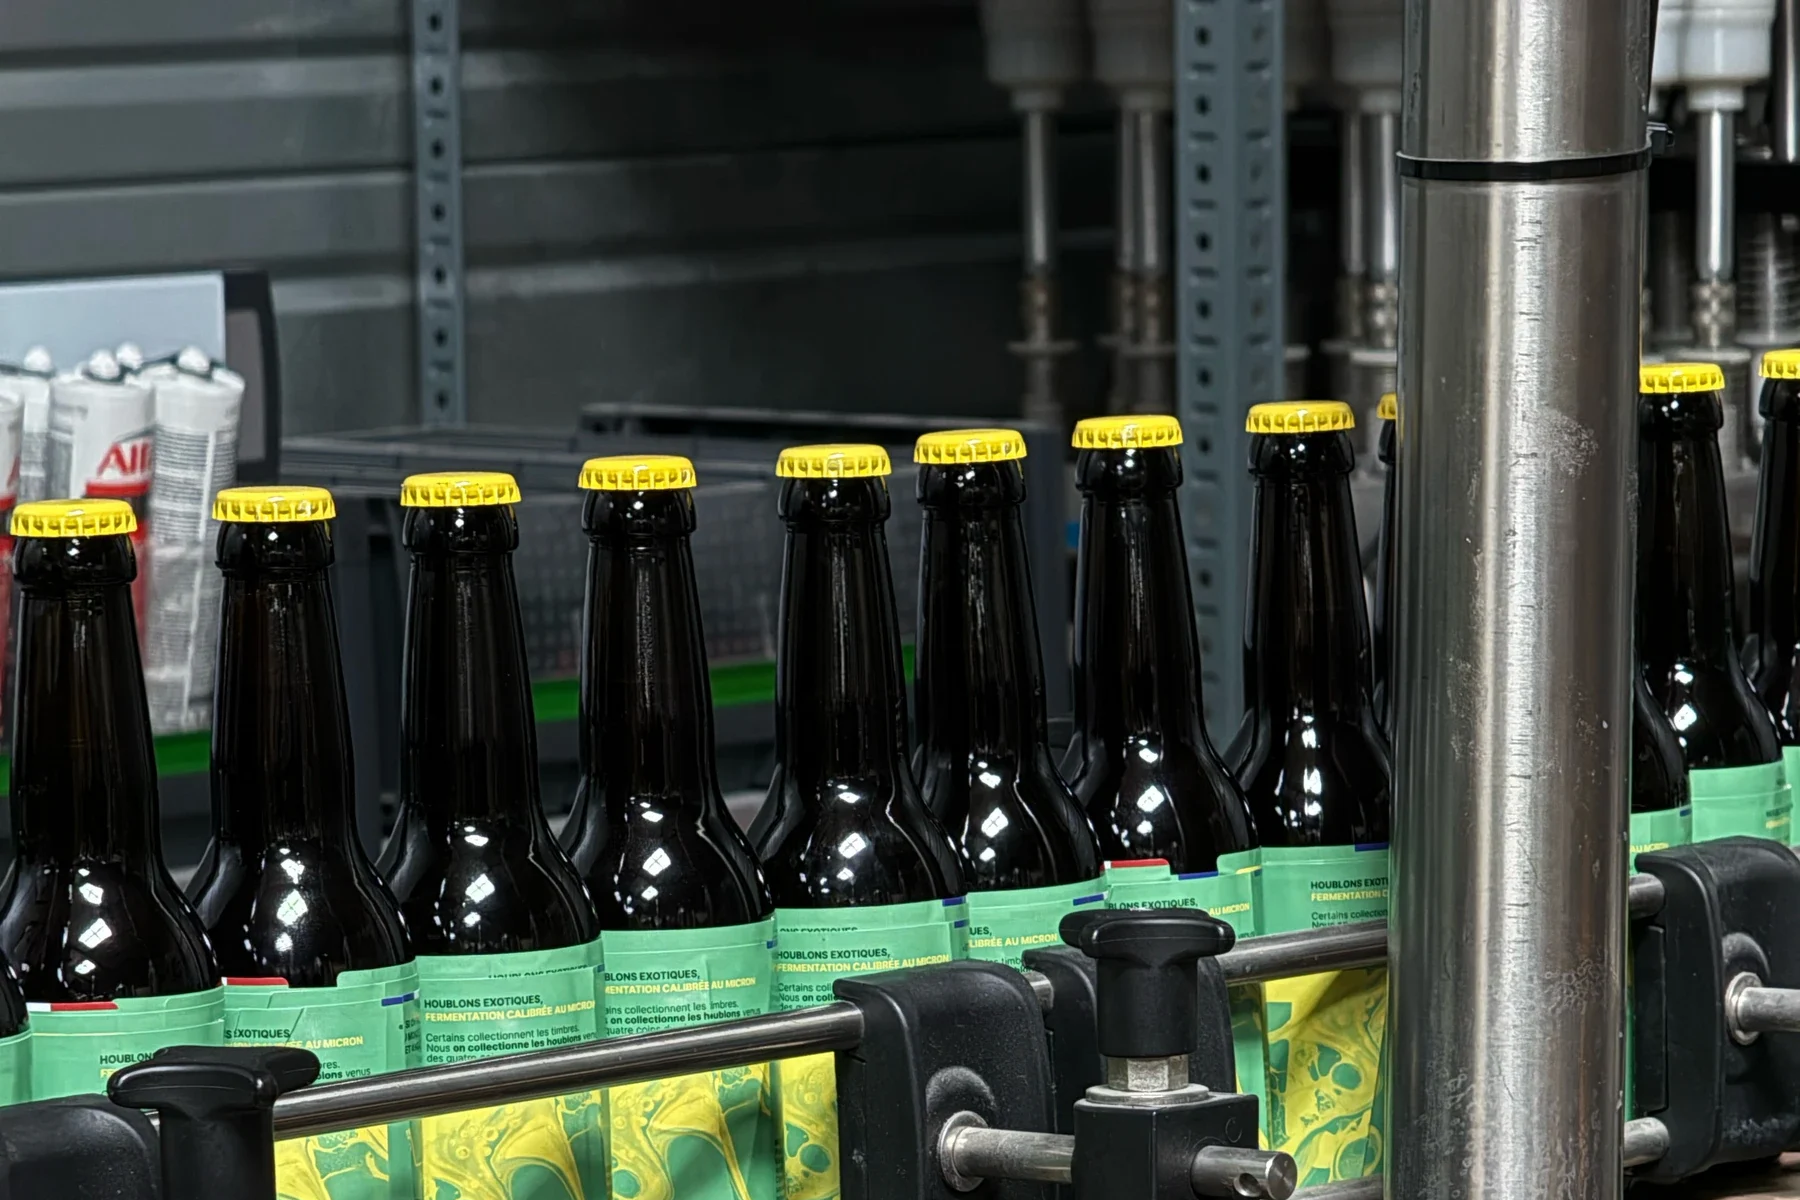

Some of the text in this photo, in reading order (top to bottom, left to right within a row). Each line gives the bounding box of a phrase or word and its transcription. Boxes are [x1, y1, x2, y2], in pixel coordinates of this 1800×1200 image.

[1311, 879, 1362, 889] HOUBLONS
[1311, 889, 1381, 901] FERMENTATION
[1209, 902, 1250, 916] AU MICRON
[1311, 910, 1348, 921] Certains
[1005, 936, 1020, 946] AU
[1021, 933, 1058, 944] MICRON
[777, 948, 891, 960] HOUBLONS EXOTIQUES,
[777, 954, 949, 973] FERMENTATION CALIBRÉE AU MICRON
[639, 969, 700, 980] EXOTIQUES,
[662, 979, 709, 993] CALIBRÉE
[711, 980, 724, 989] AU
[725, 977, 756, 988] MICRON
[778, 983, 813, 992] Certains
[424, 995, 543, 1009] HOUBLONS EXOTIQUES,
[779, 993, 800, 1002] Nous
[425, 1010, 505, 1022] FERMENTATION
[506, 1006, 553, 1019] CALIBRÉE
[555, 1004, 567, 1014] AU
[624, 1002, 691, 1014] collectionnent
[693, 1001, 707, 1011] les
[610, 1017, 622, 1025] on
[624, 1014, 685, 1025] collectionne
[687, 1012, 701, 1021] les
[425, 1032, 466, 1042] Certains
[467, 1029, 534, 1042] collectionnent
[536, 1026, 549, 1037] les
[551, 1024, 579, 1036] timbres.
[305, 1040, 321, 1049] AU
[323, 1036, 363, 1048] MICRON
[426, 1043, 451, 1053] Nous
[453, 1045, 466, 1053] on
[467, 1039, 529, 1053] collectionne
[531, 1038, 545, 1049] les
[546, 1034, 582, 1047] houblons
[100, 1052, 154, 1064] HOUBLON
[426, 1054, 444, 1063] des
[345, 1067, 371, 1078] venus
